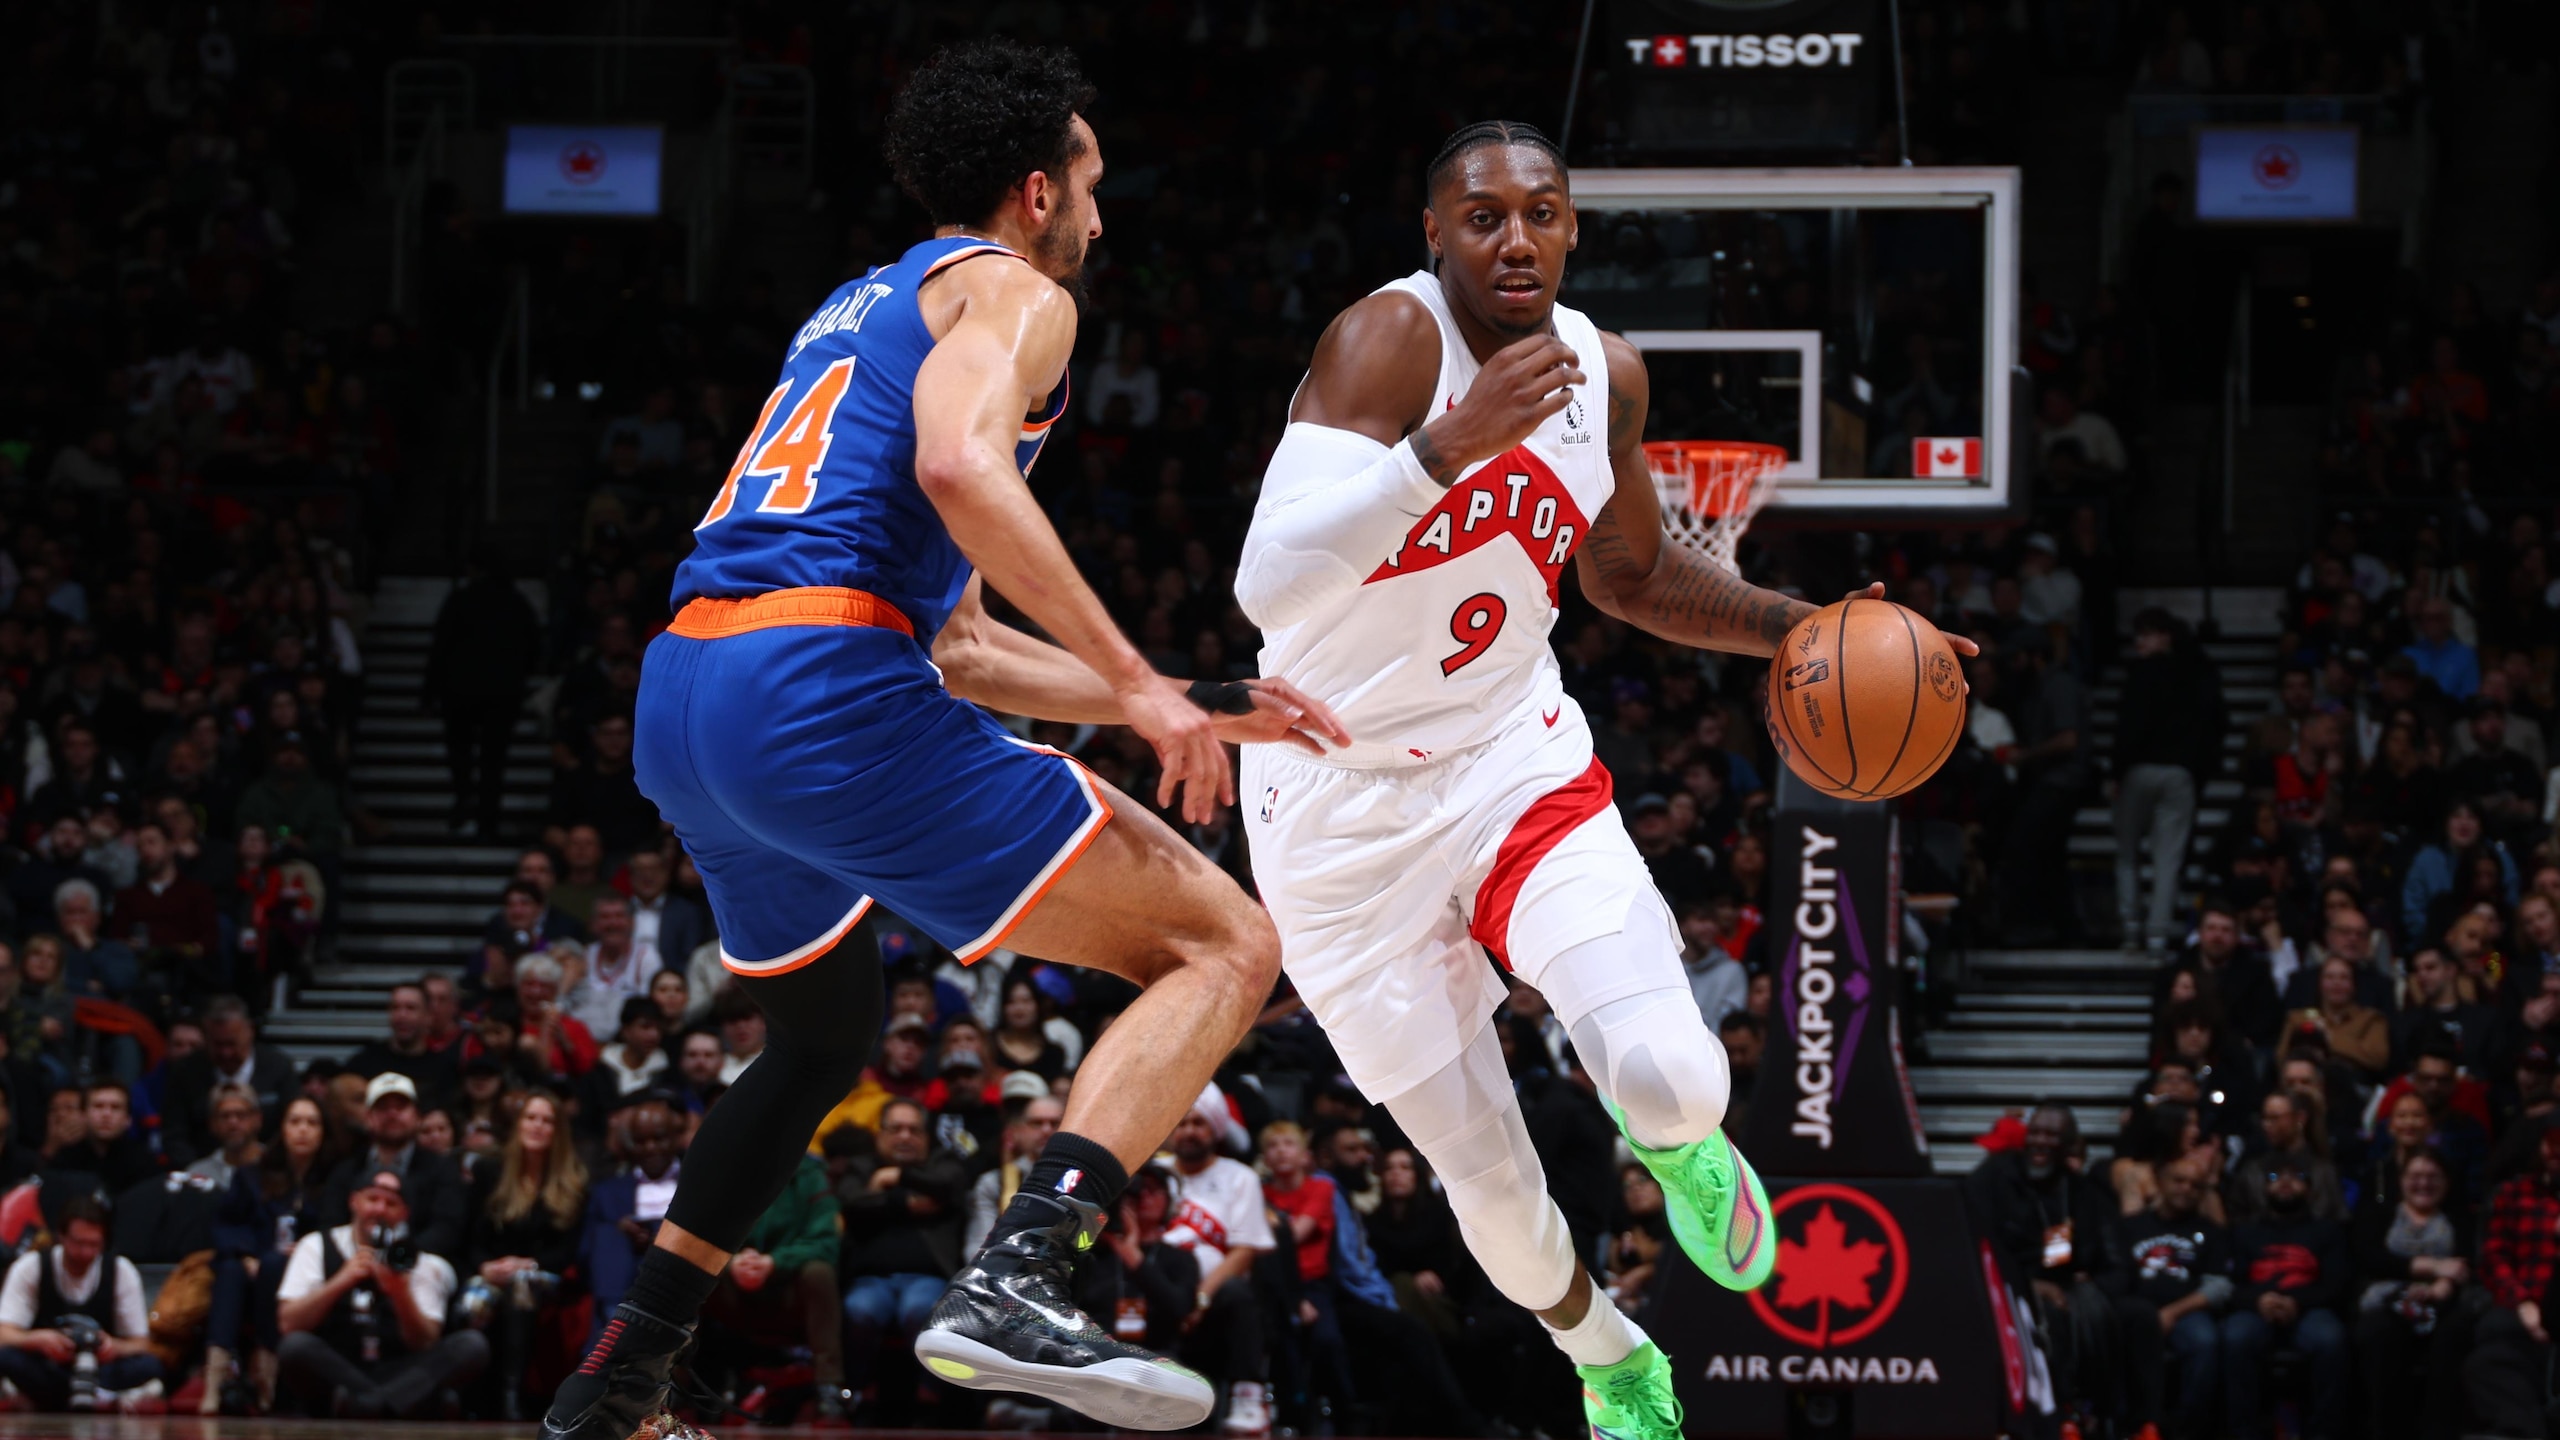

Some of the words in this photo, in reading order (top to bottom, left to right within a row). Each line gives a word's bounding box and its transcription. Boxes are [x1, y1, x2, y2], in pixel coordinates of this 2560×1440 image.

[1690, 33, 1862, 67] TISSOT
[788, 283, 894, 363] SHAMET
[1561, 433, 1575, 445] Sun
[1576, 431, 1591, 443] Life
[1440, 592, 1507, 677] 9
[1705, 1355, 1771, 1381] AIR
[1779, 1355, 1940, 1383] CANADA
